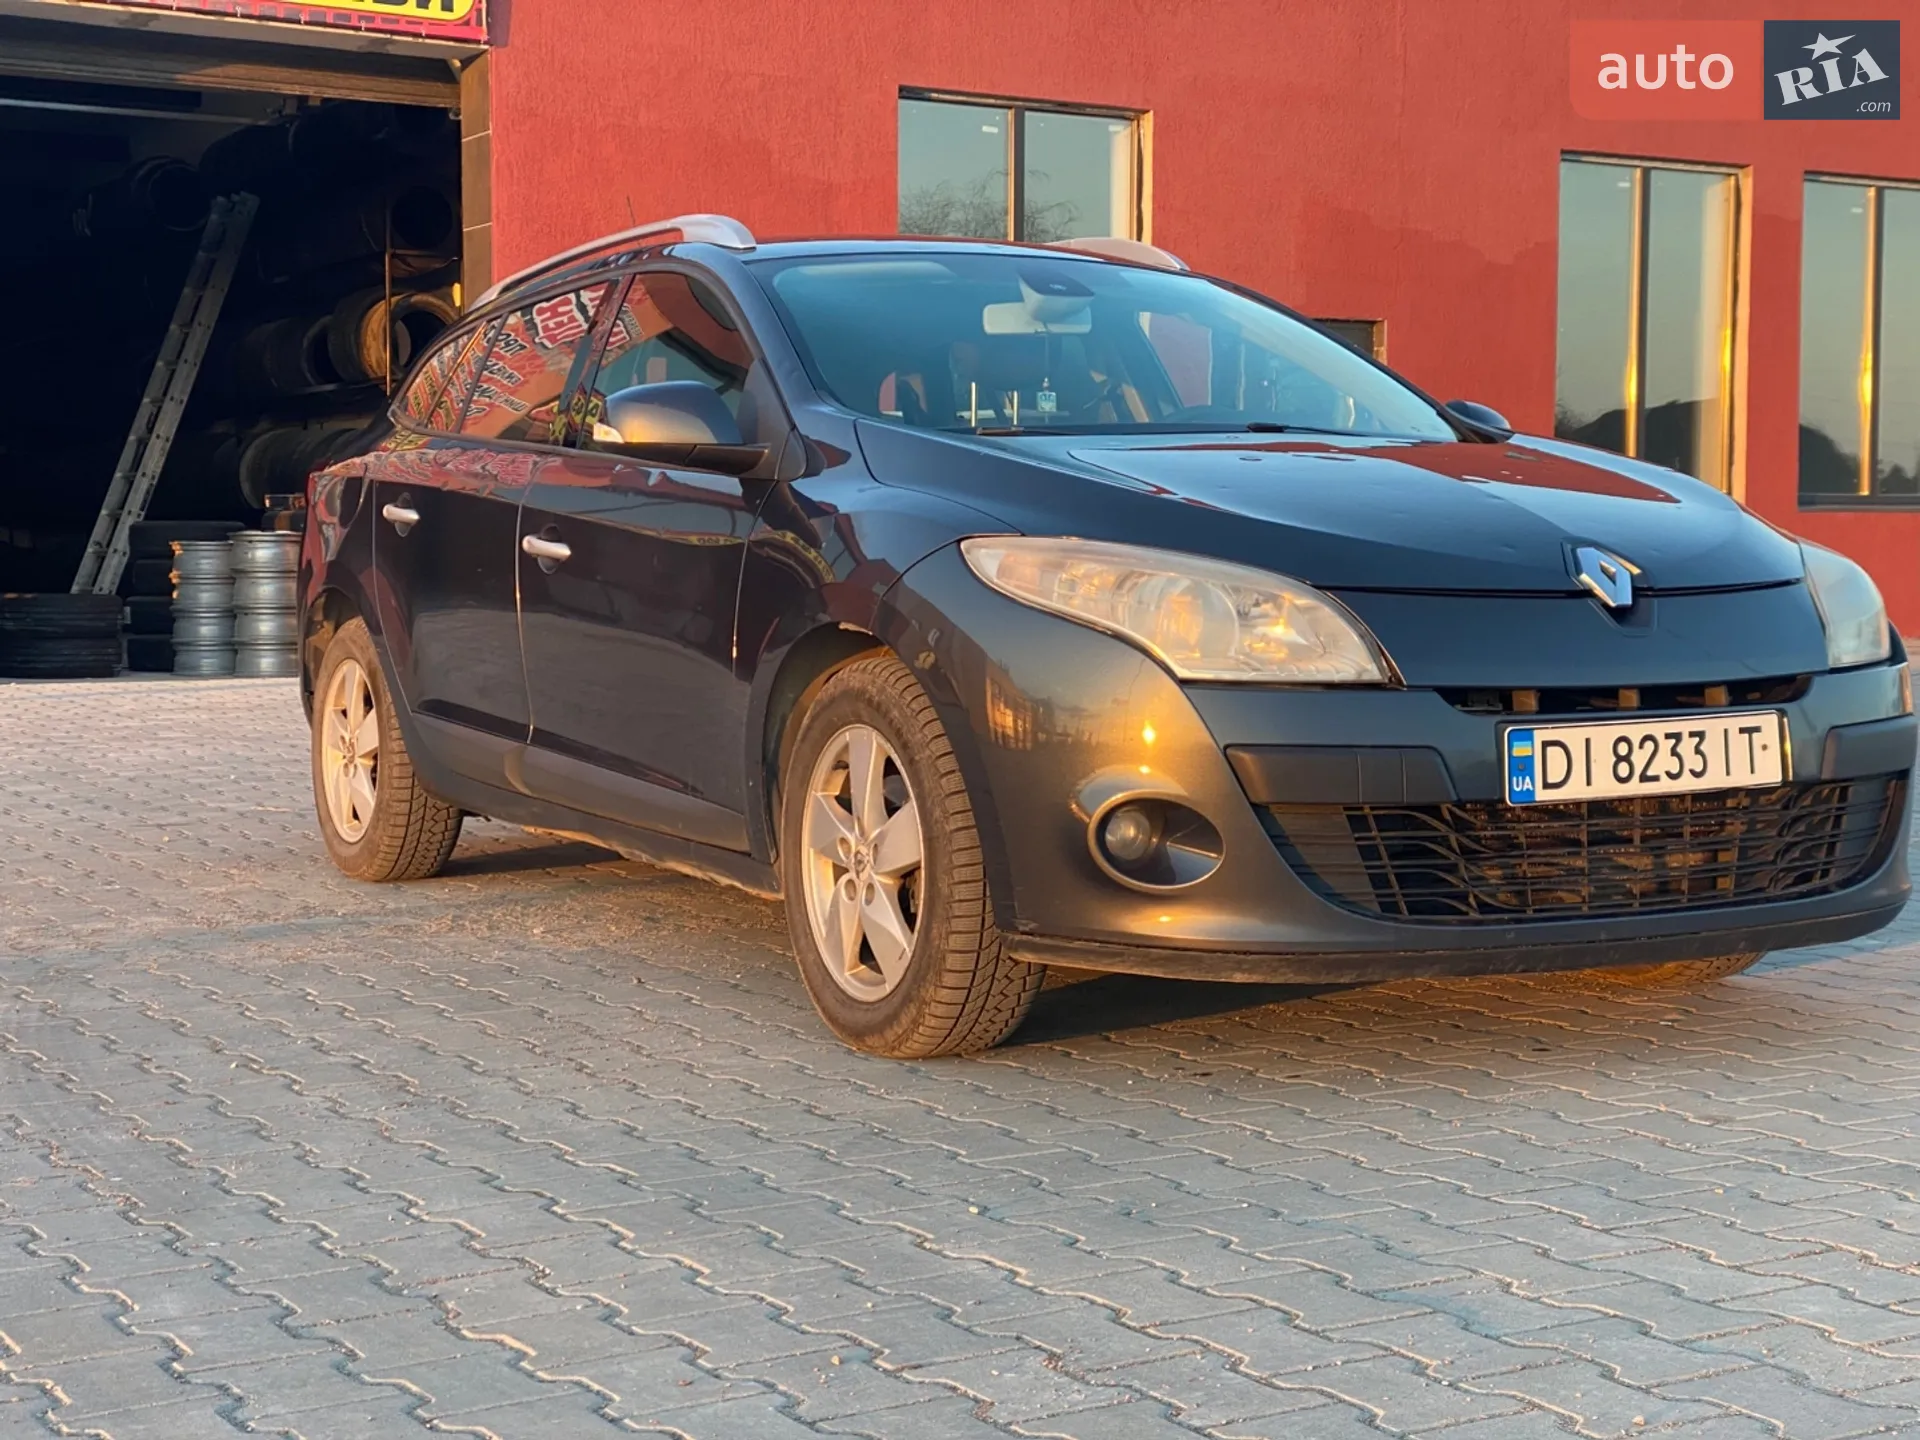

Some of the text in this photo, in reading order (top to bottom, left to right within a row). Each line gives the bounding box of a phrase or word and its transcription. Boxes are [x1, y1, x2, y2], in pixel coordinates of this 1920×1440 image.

[1541, 725, 1762, 790] DI 8233 IT
[1513, 778, 1533, 791] UA
